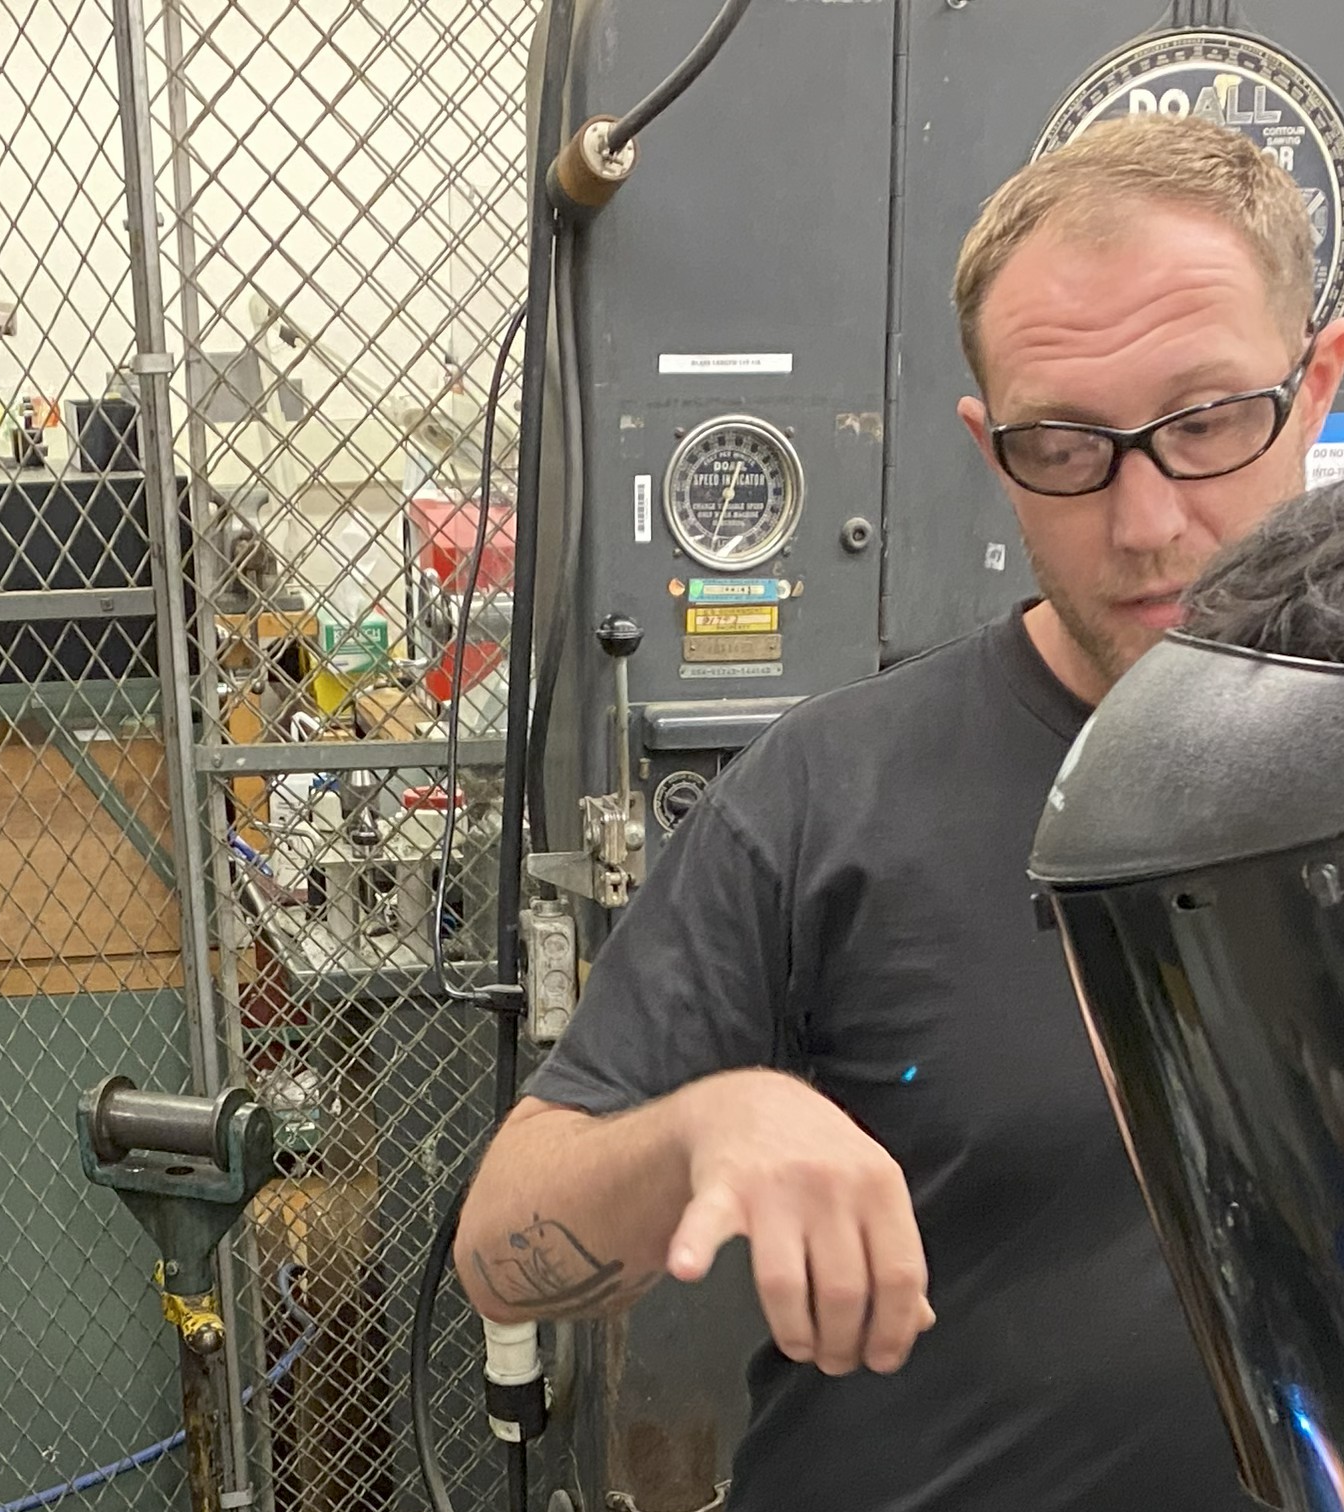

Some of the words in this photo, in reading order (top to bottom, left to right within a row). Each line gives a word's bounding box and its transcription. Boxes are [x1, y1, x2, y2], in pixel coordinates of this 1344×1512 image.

[1263, 126, 1305, 136] CONTOUR
[1313, 449, 1327, 458] DO
[693, 474, 719, 485] SPEED
[722, 473, 765, 486] INICATOR
